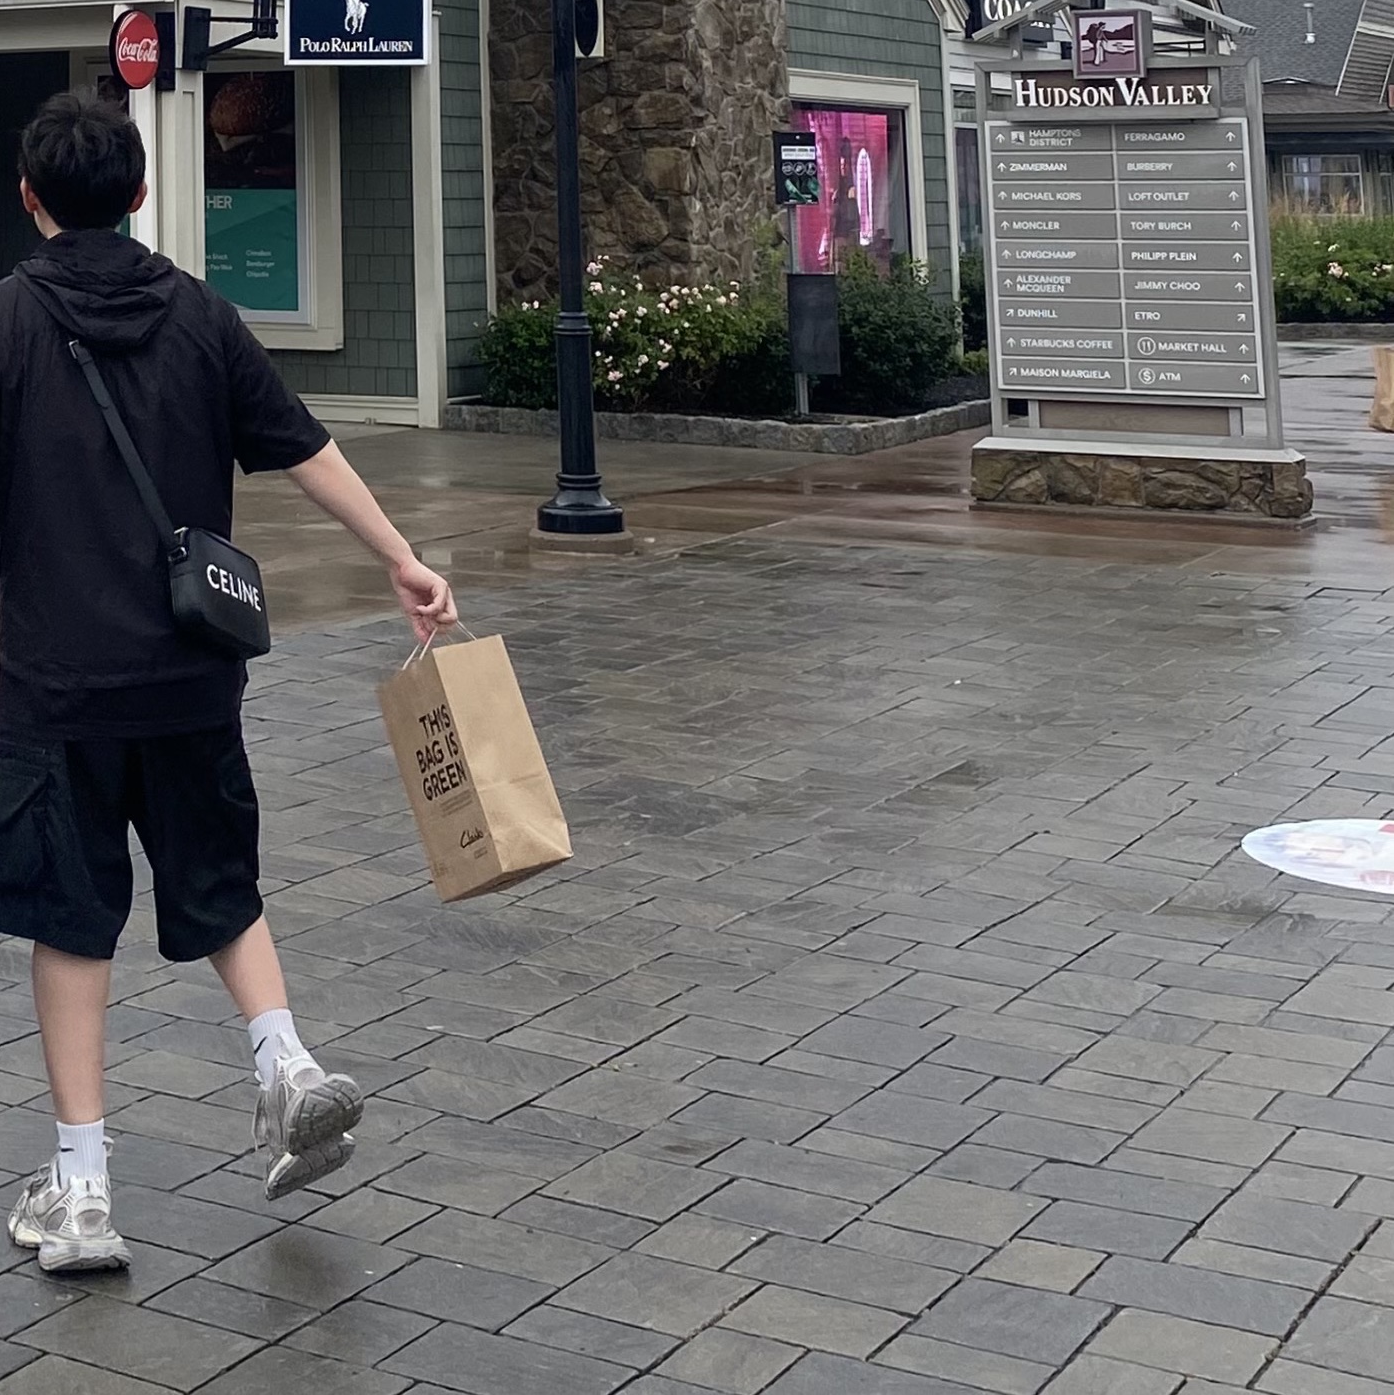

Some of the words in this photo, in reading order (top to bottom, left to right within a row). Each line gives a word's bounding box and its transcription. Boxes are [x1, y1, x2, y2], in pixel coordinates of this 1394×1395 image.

[300, 37, 330, 52] POLO
[331, 37, 367, 52] RALPH
[368, 37, 413, 52] LAUREN
[1014, 79, 1115, 107] HUDSON
[1115, 77, 1213, 106] VALLEY
[1028, 128, 1082, 138] HAMPTONS
[1124, 132, 1186, 141] FERRAGAMO
[1029, 138, 1073, 147] DISTRICT
[1126, 162, 1173, 171] BURBERRY
[1011, 192, 1055, 201] MICHAEL
[1056, 192, 1082, 201] KORS
[1128, 192, 1152, 201] LOFT
[1153, 192, 1190, 201] OUTLET
[1012, 221, 1060, 230] MONCLER
[1130, 221, 1156, 230] TORY
[1158, 221, 1192, 231] BURCH
[1015, 250, 1077, 260] LONGCHAMP
[1131, 252, 1168, 261] PHILIPP
[1169, 252, 1197, 261] PLEIN
[1016, 275, 1072, 284] ALEXANDER
[1016, 284, 1065, 293] MCQUEEN
[1134, 281, 1168, 290] JIMMY
[1169, 281, 1201, 291] CHOO
[1017, 309, 1058, 318] DUNHILL
[1134, 311, 1161, 320] ETRO
[1020, 338, 1075, 348] STARBUCKS
[1076, 339, 1113, 349] COFFEE
[1158, 342, 1200, 352] MARKET
[1201, 343, 1227, 353] HALL
[1020, 367, 1059, 377] MAISON
[1061, 369, 1111, 379] MARGIELA
[1158, 372, 1181, 382] ATM
[206, 563, 262, 612] CELINE
[419, 704, 451, 739] THIS
[415, 740, 445, 774] BAG
[446, 731, 459, 756] IS
[423, 761, 468, 801] GREEN
